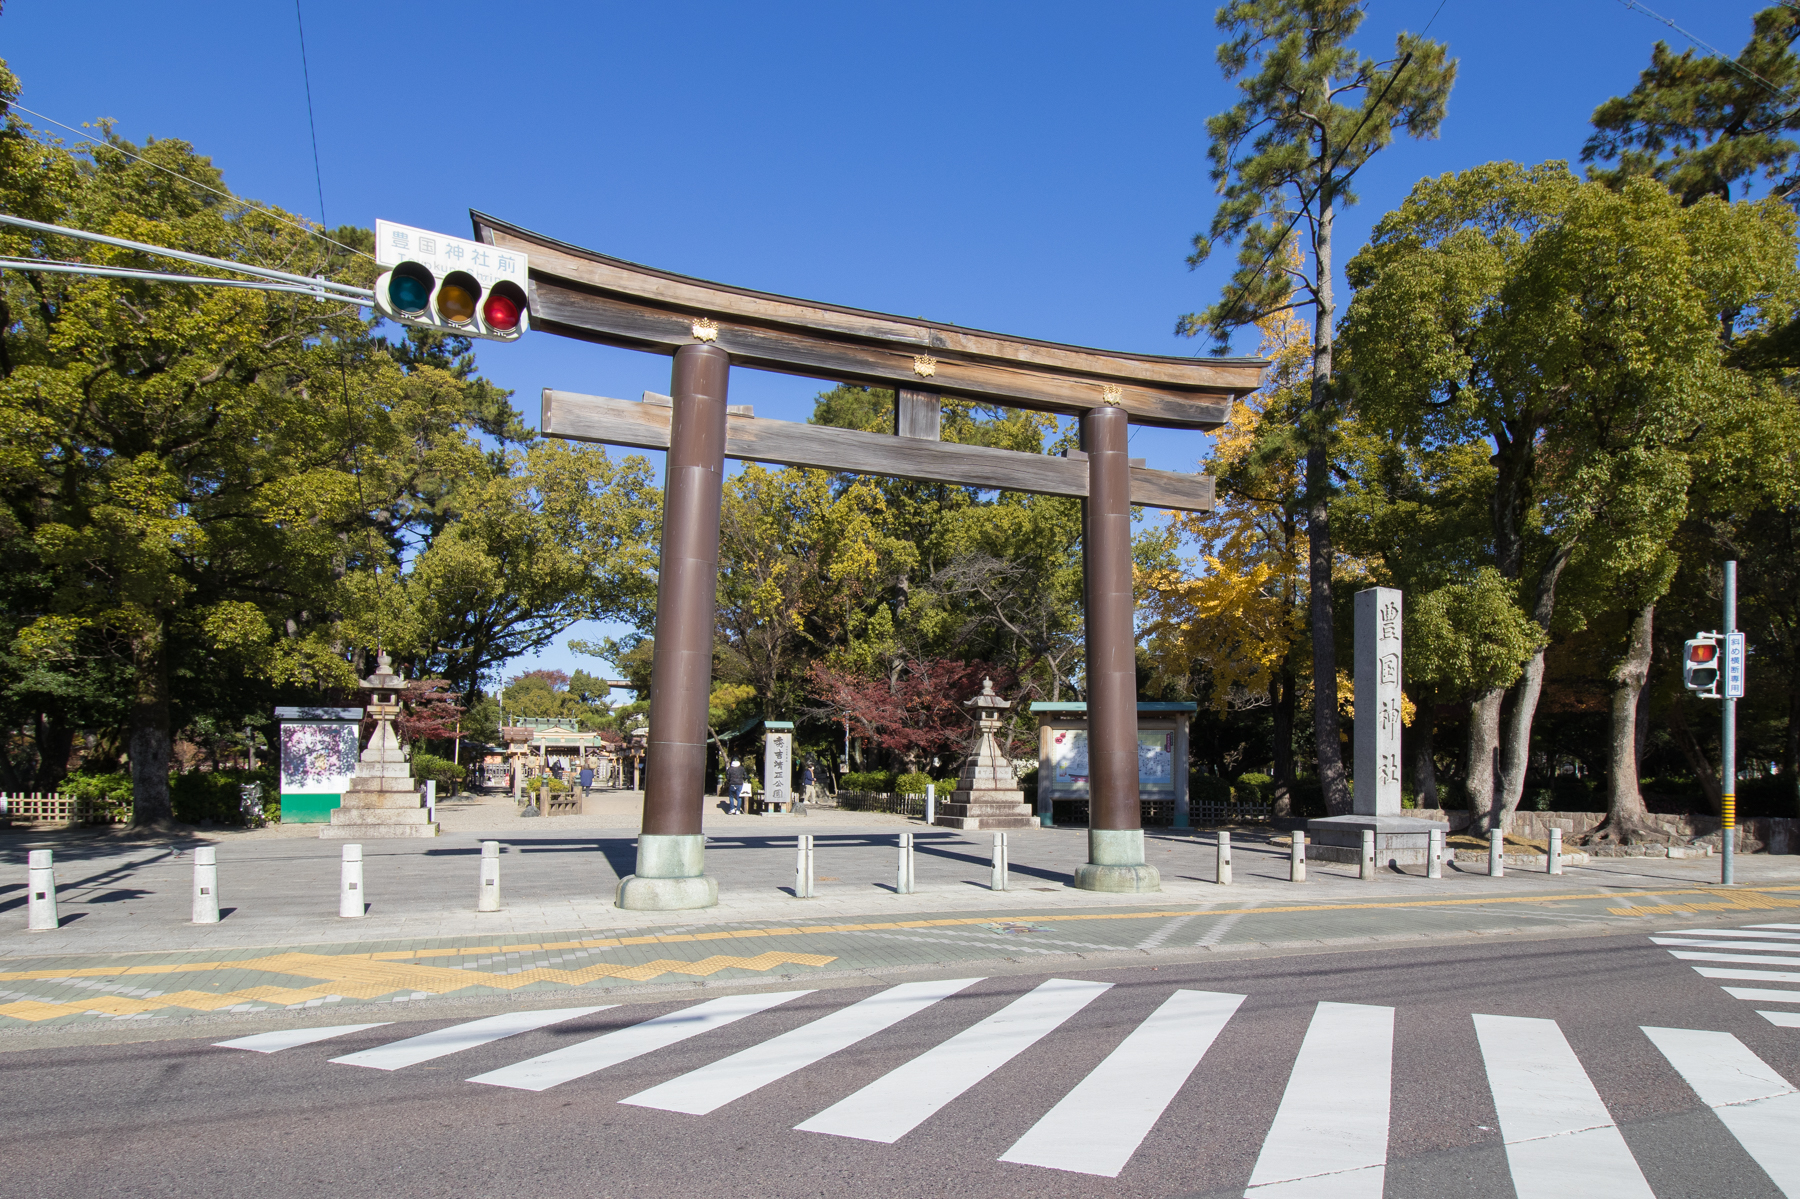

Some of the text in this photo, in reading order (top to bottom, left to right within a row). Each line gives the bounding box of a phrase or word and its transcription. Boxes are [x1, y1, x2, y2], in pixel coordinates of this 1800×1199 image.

[391, 231, 515, 274] 豊国神社前
[1379, 601, 1400, 785] 豊国神社
[1730, 638, 1740, 692] 斜め横断専用
[773, 736, 785, 799] 秀吉清正公園
